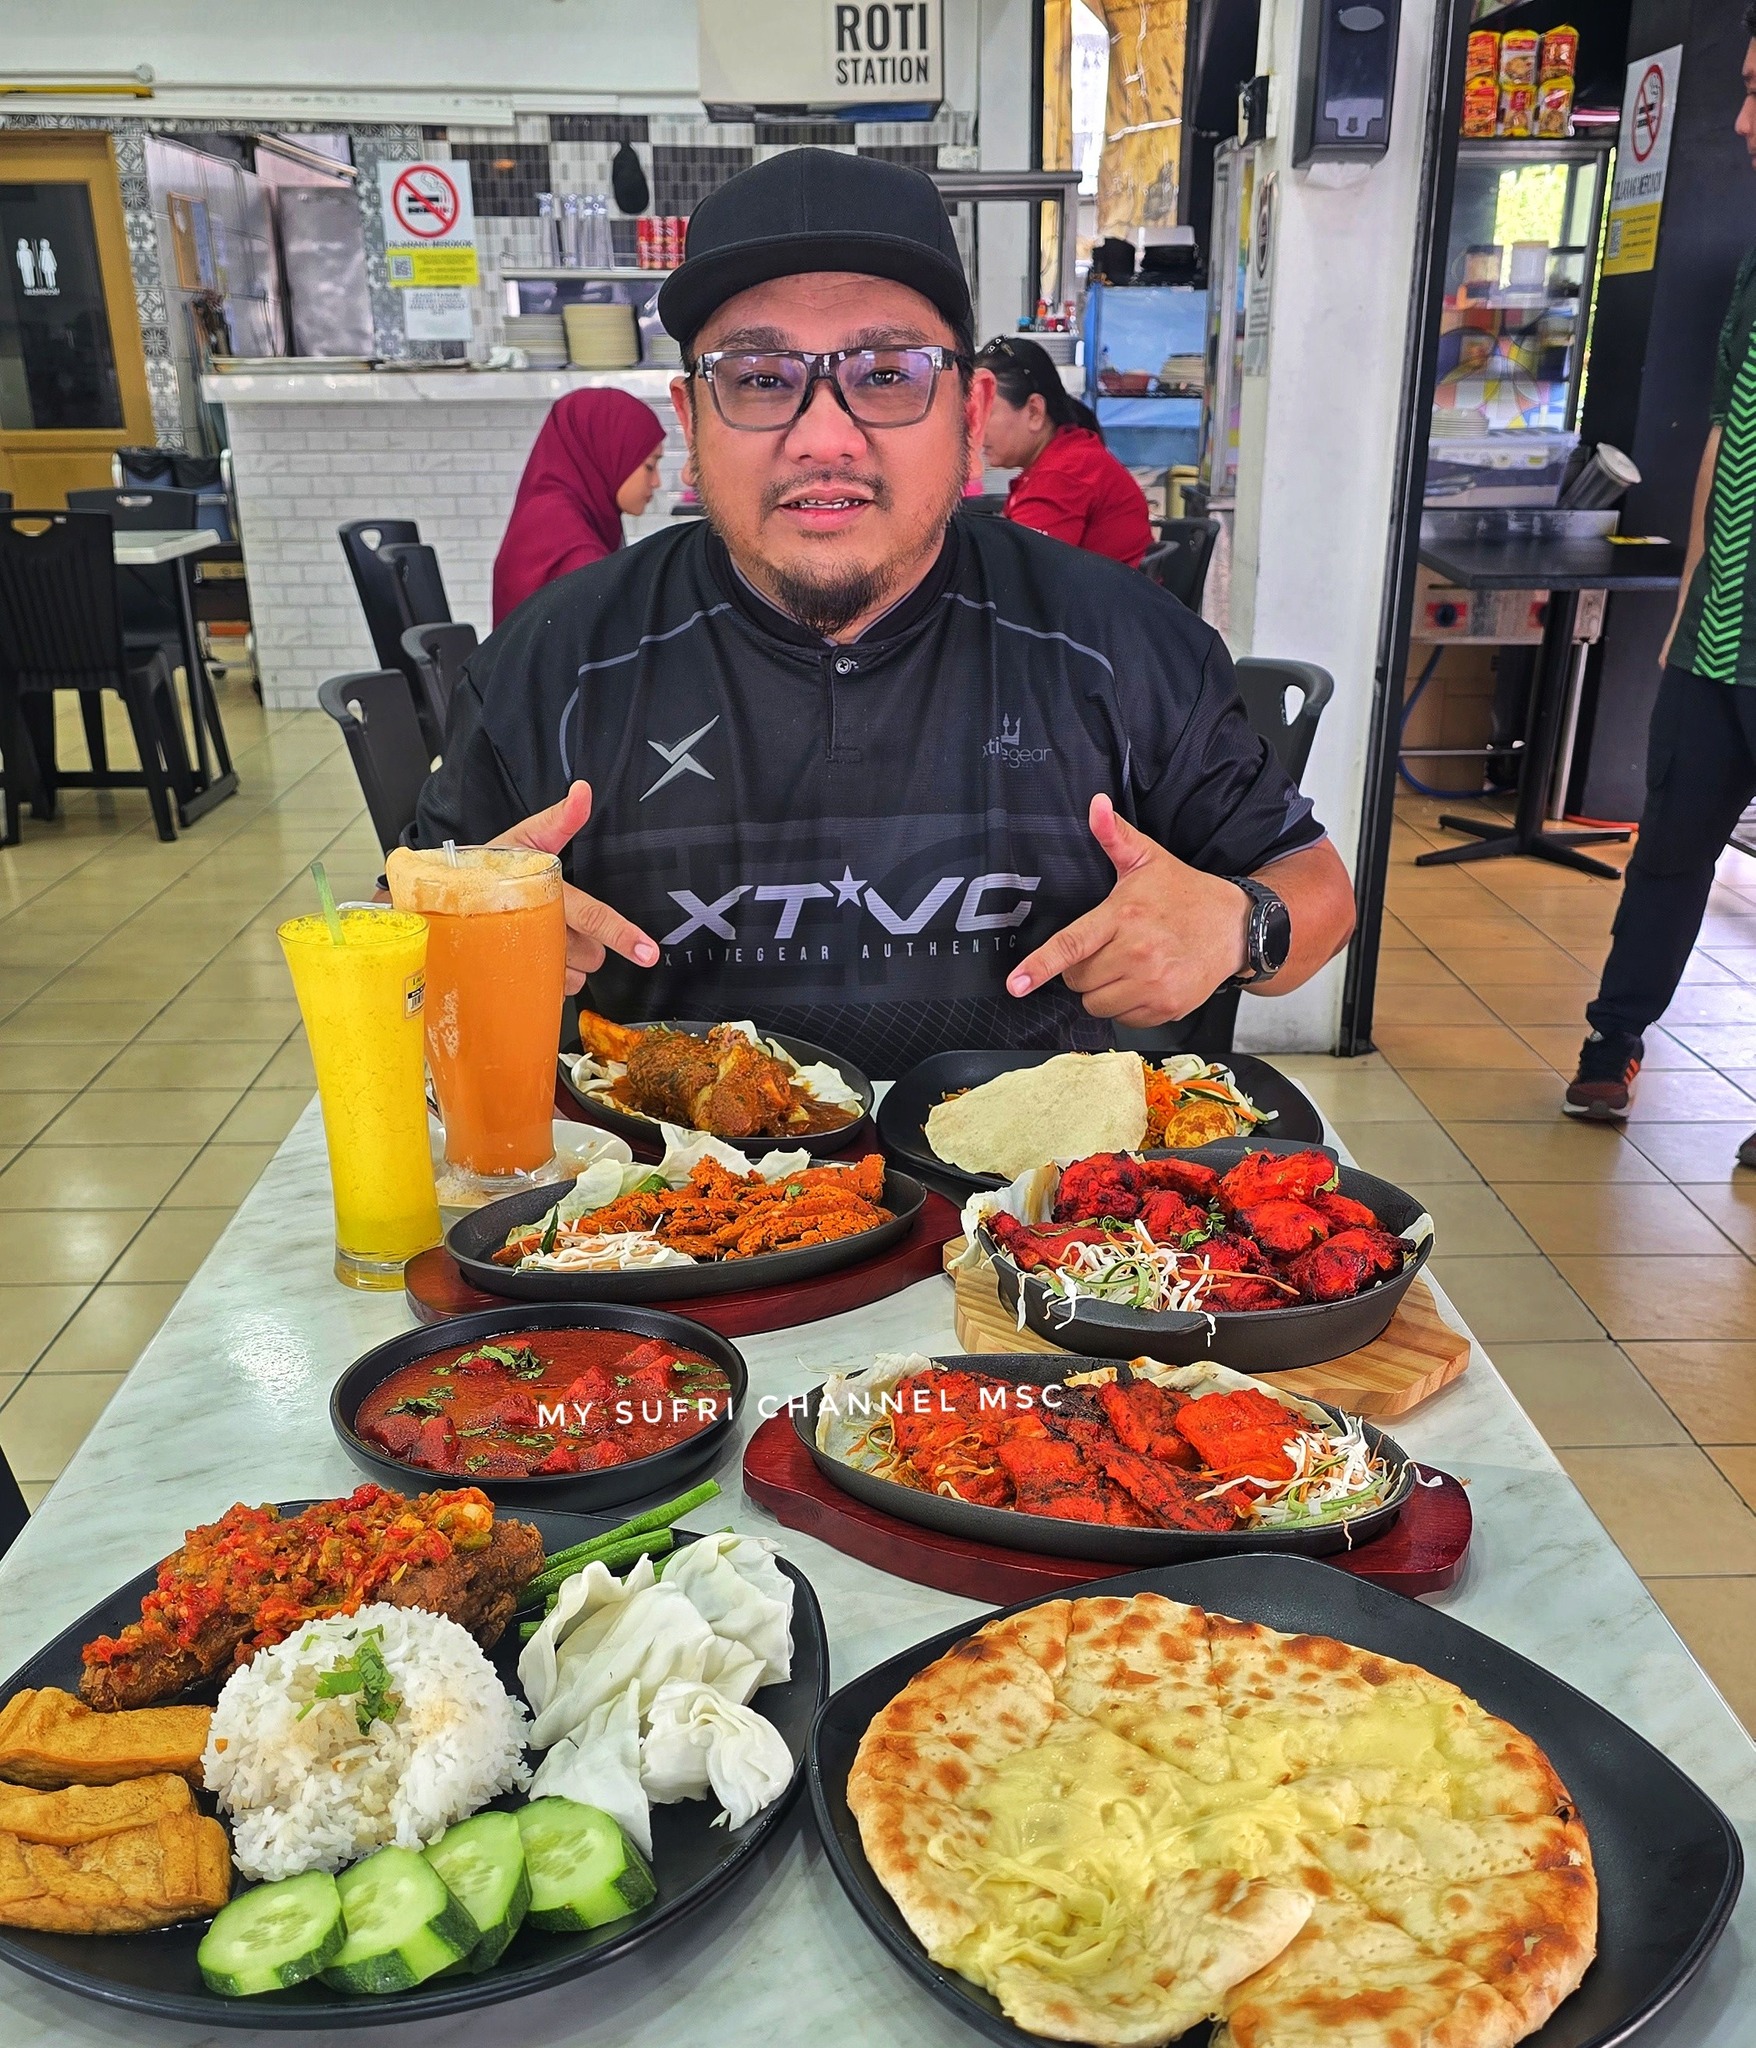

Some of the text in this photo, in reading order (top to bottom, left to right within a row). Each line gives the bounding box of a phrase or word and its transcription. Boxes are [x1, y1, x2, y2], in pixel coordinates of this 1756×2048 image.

[836, 4, 926, 51] ROTI
[837, 56, 928, 84] STATION
[862, 934, 1016, 959] AUTHENTC
